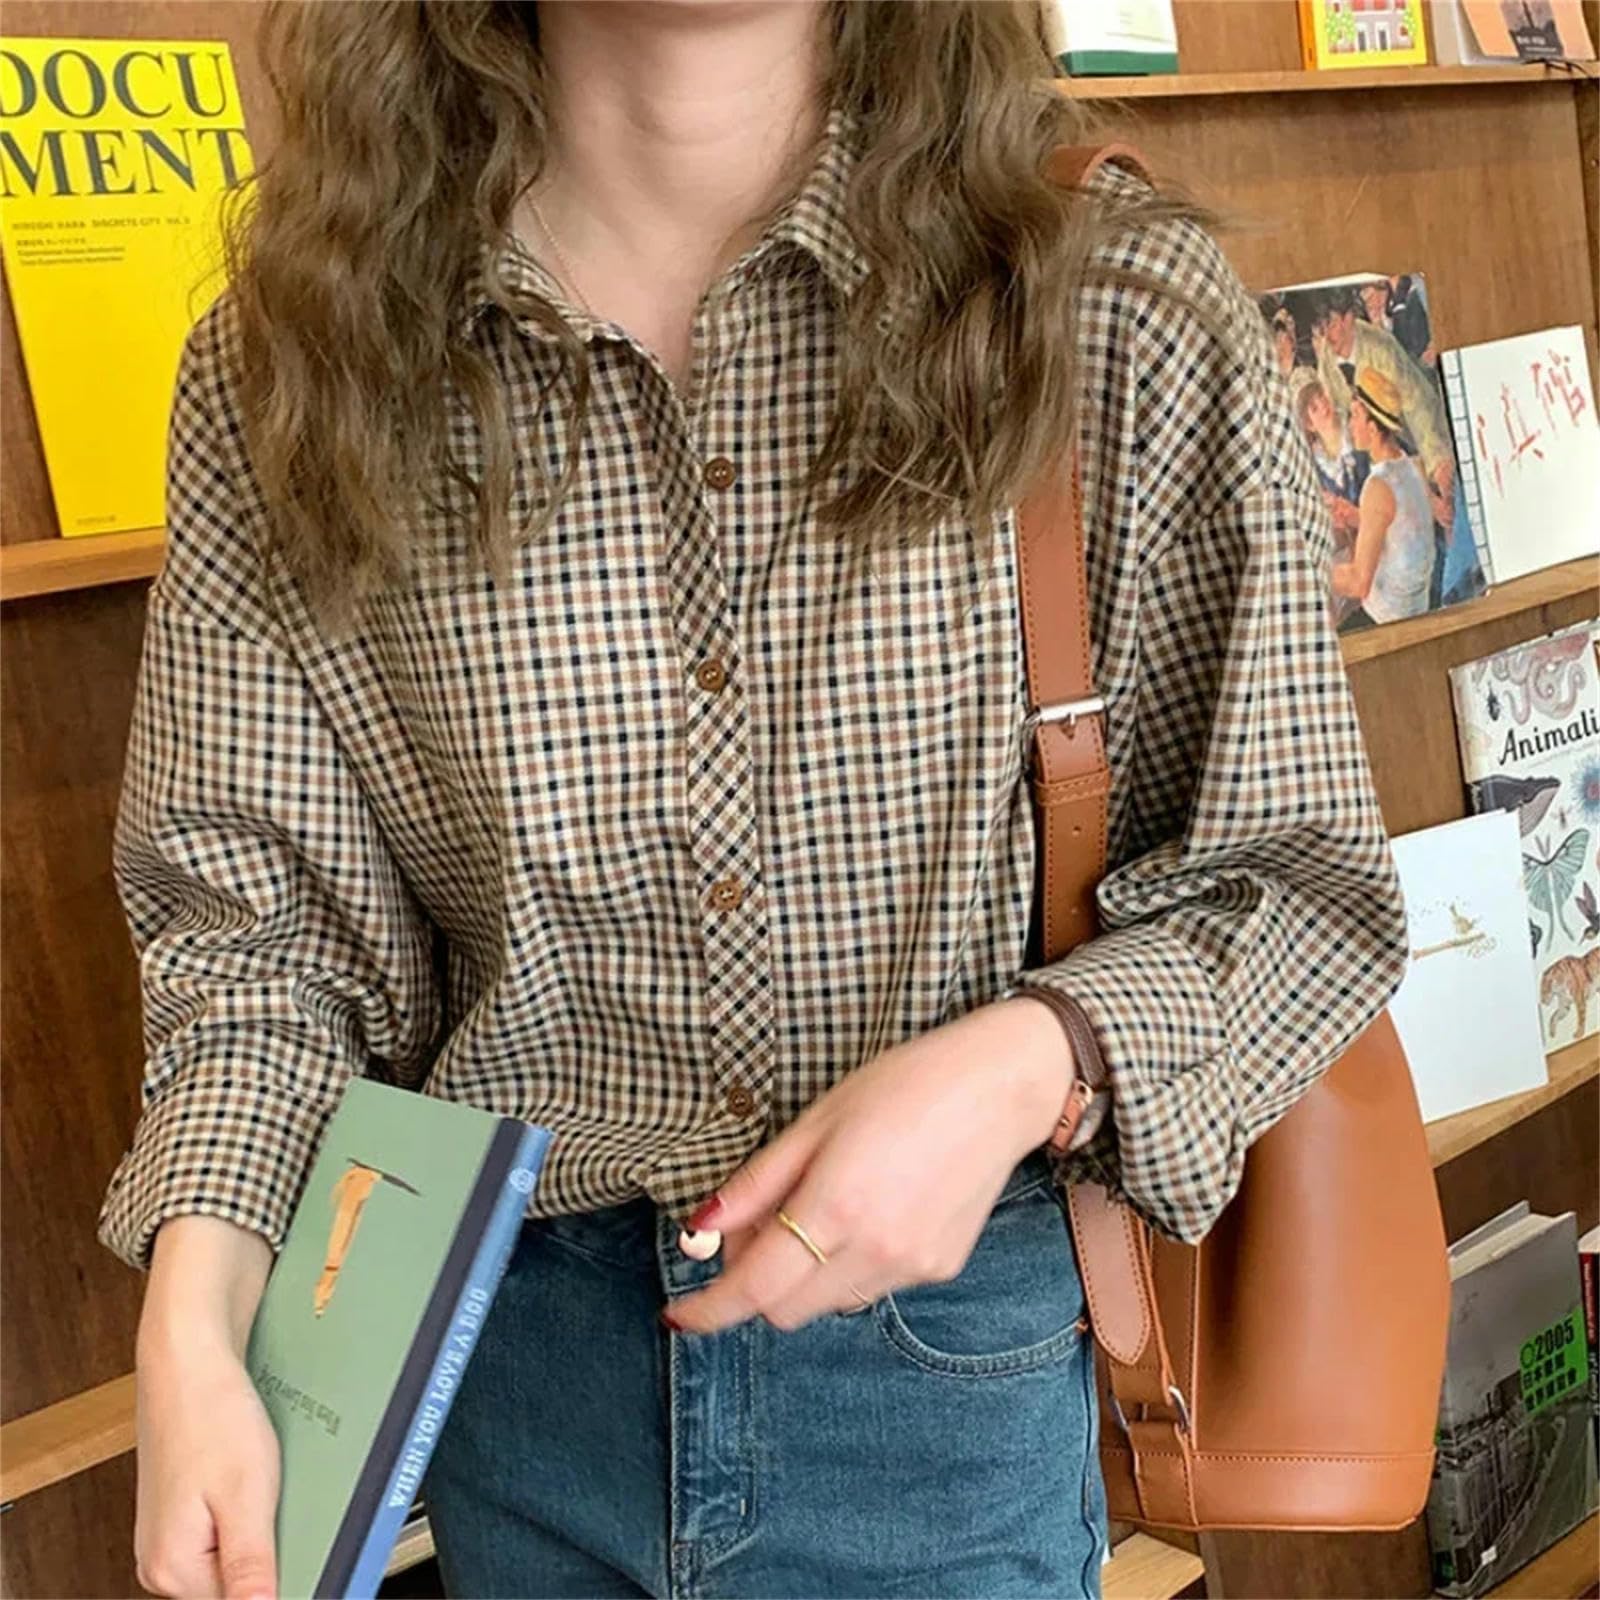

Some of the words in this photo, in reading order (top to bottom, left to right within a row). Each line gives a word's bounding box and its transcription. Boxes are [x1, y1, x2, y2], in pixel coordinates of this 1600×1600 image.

[0, 127, 247, 198] MENT
[388, 1449, 426, 1508] WHEN
[414, 1405, 442, 1444] YOU
[431, 1348, 465, 1402] LOVE
[453, 1333, 471, 1348] A
